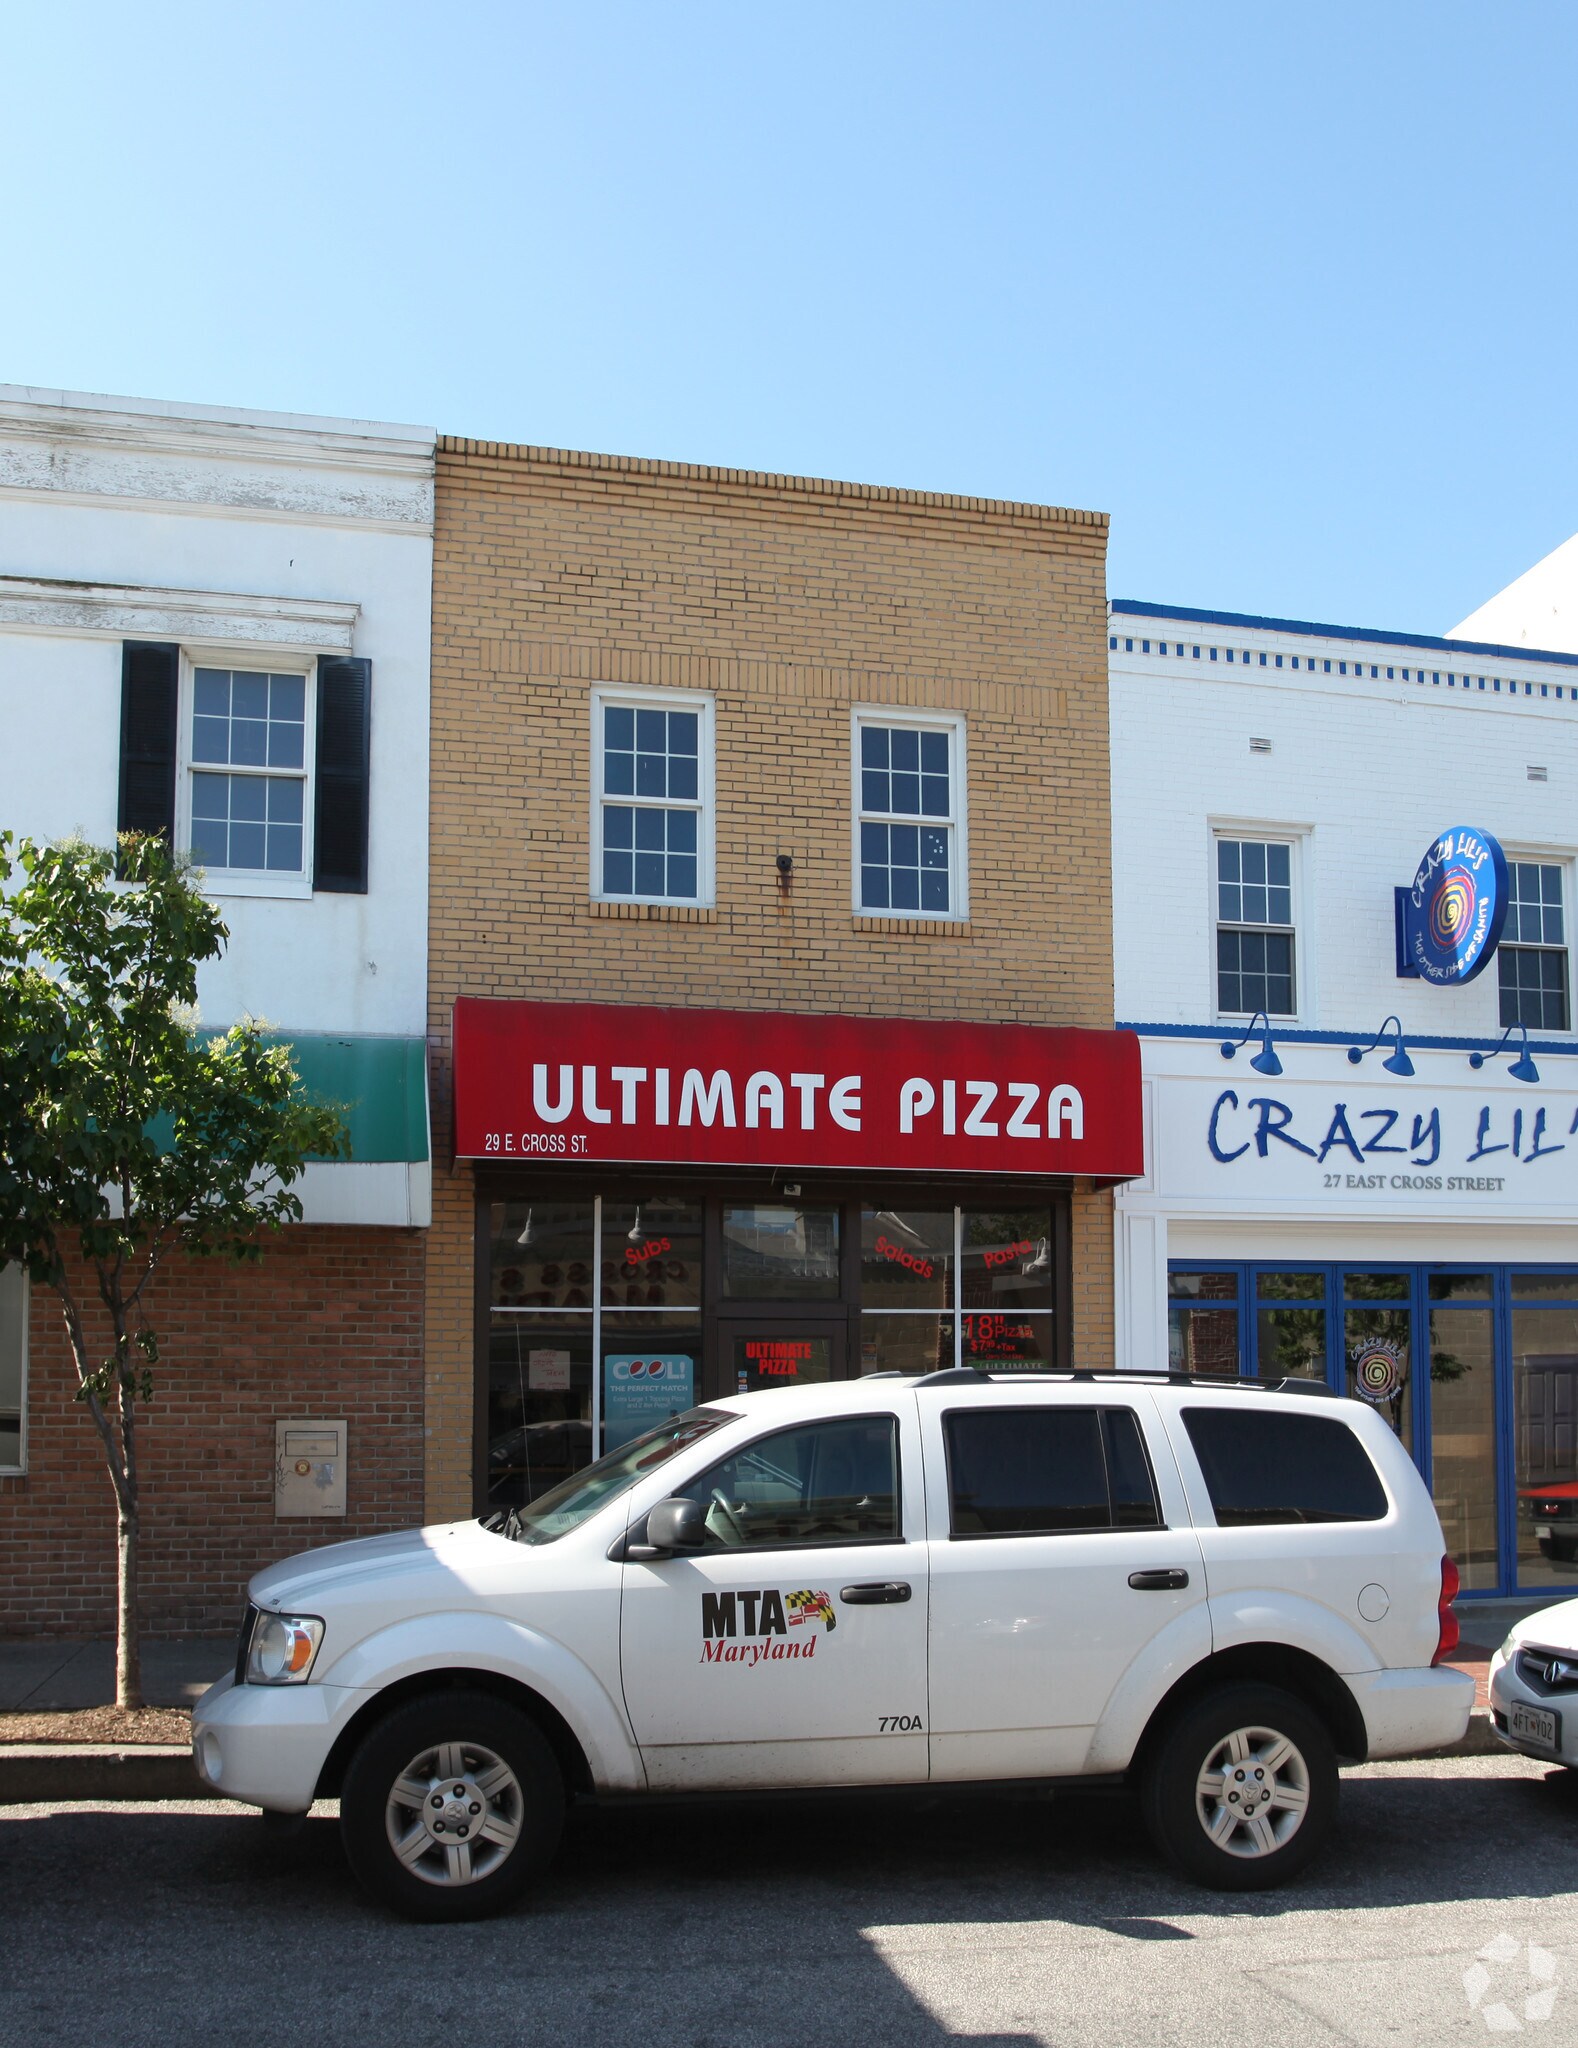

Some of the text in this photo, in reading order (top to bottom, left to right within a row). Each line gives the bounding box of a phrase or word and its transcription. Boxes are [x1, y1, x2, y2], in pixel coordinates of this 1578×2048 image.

[1411, 834, 1454, 909] CRAZY
[1411, 931, 1425, 955] THE
[1418, 956, 1444, 978] OTHER
[532, 1063, 1084, 1140] ULTIMATE PIZZA
[485, 1133, 588, 1153] 29 E. CROSS ST.
[1206, 1089, 1442, 1167] CRAZY
[1323, 1173, 1505, 1192] 27 EAST CROSS STREET
[625, 1236, 672, 1265] Subs
[874, 1235, 934, 1279] Salads
[983, 1239, 1033, 1270] Pasta
[994, 1323, 1035, 1339] Pizza
[745, 1342, 812, 1359] ULTIMATE
[758, 1359, 798, 1375] PIZZA
[610, 1385, 688, 1393] THE PERFECT MATCH
[701, 1589, 787, 1638] MTA
[699, 1634, 817, 1668] Maryland
[878, 1715, 923, 1732] 770A
